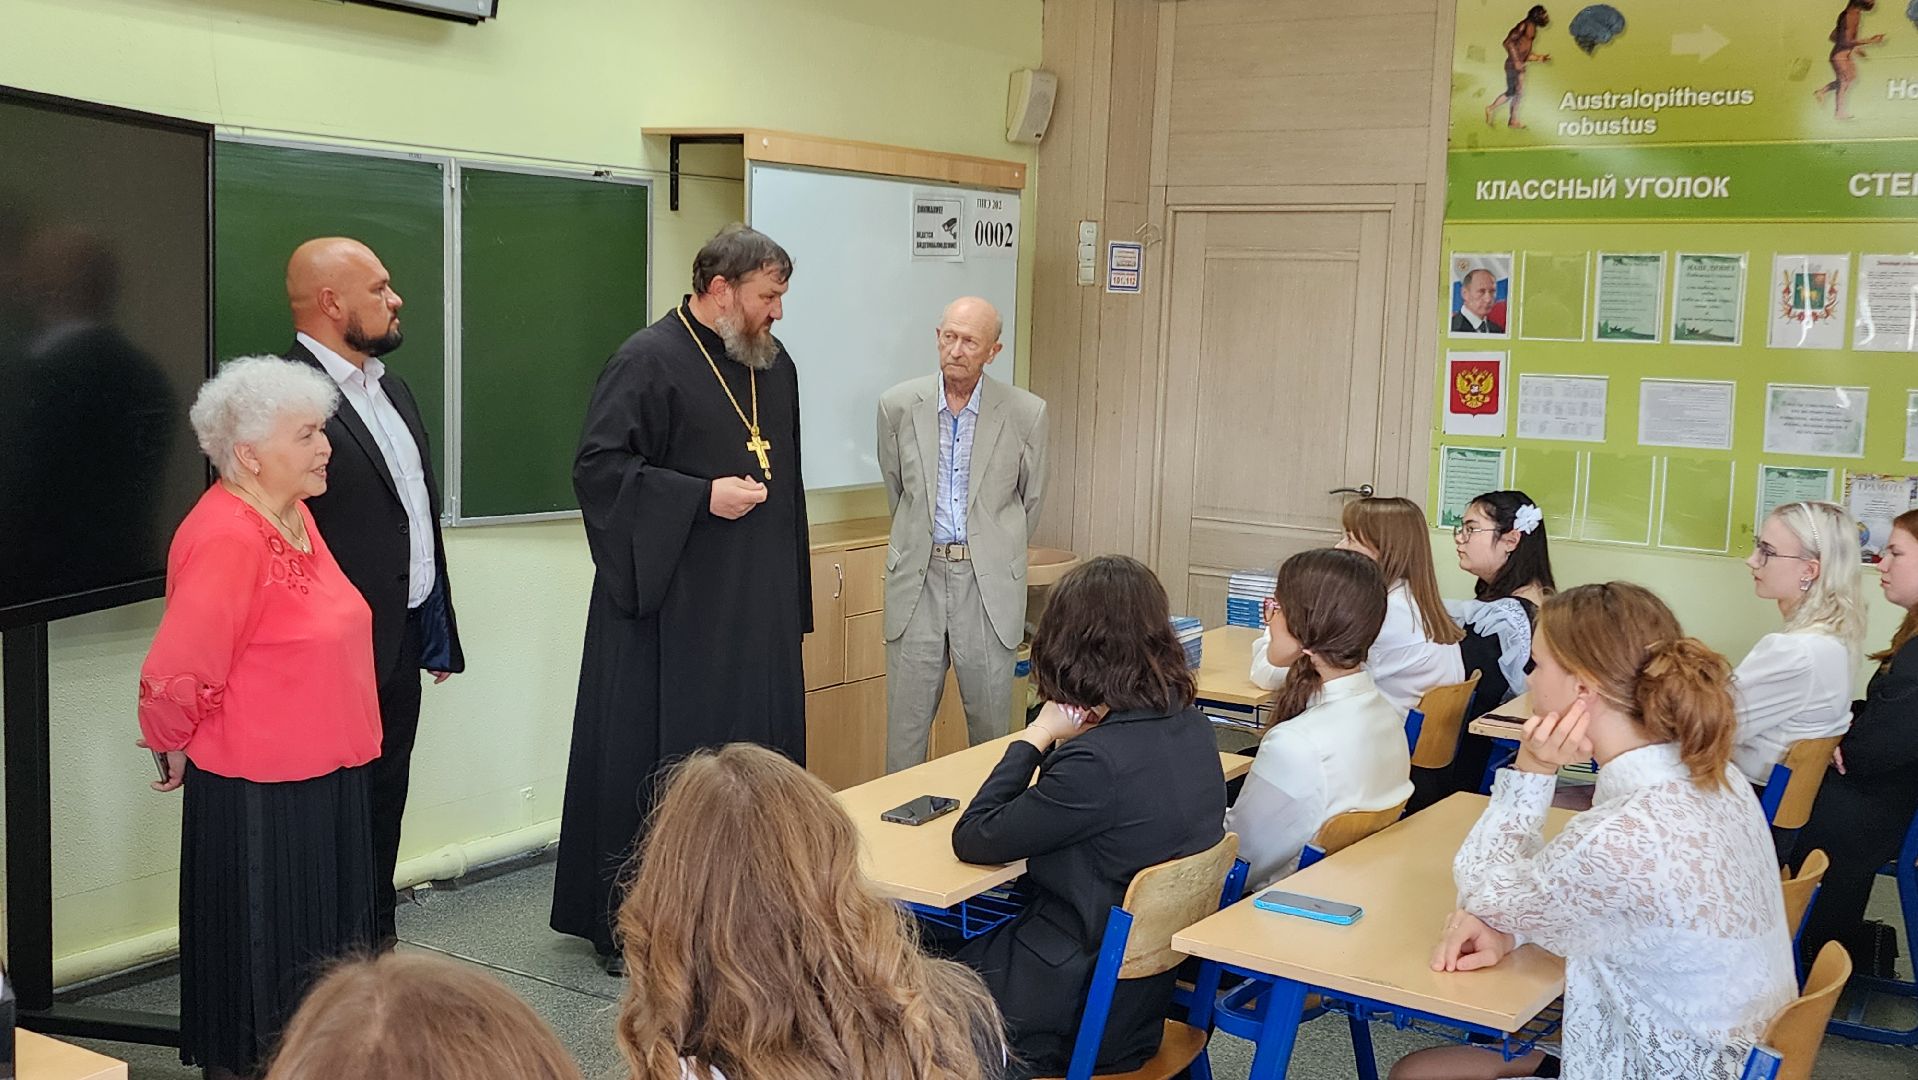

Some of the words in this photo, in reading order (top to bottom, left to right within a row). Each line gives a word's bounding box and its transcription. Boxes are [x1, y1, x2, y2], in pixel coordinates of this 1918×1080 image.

[1559, 87, 1755, 112] Australopithecus
[1558, 116, 1657, 136] robustus
[1476, 174, 1617, 200] КЛАССНЫЙ
[1624, 176, 1731, 199] УГОЛОК
[974, 219, 1013, 248] 0002
